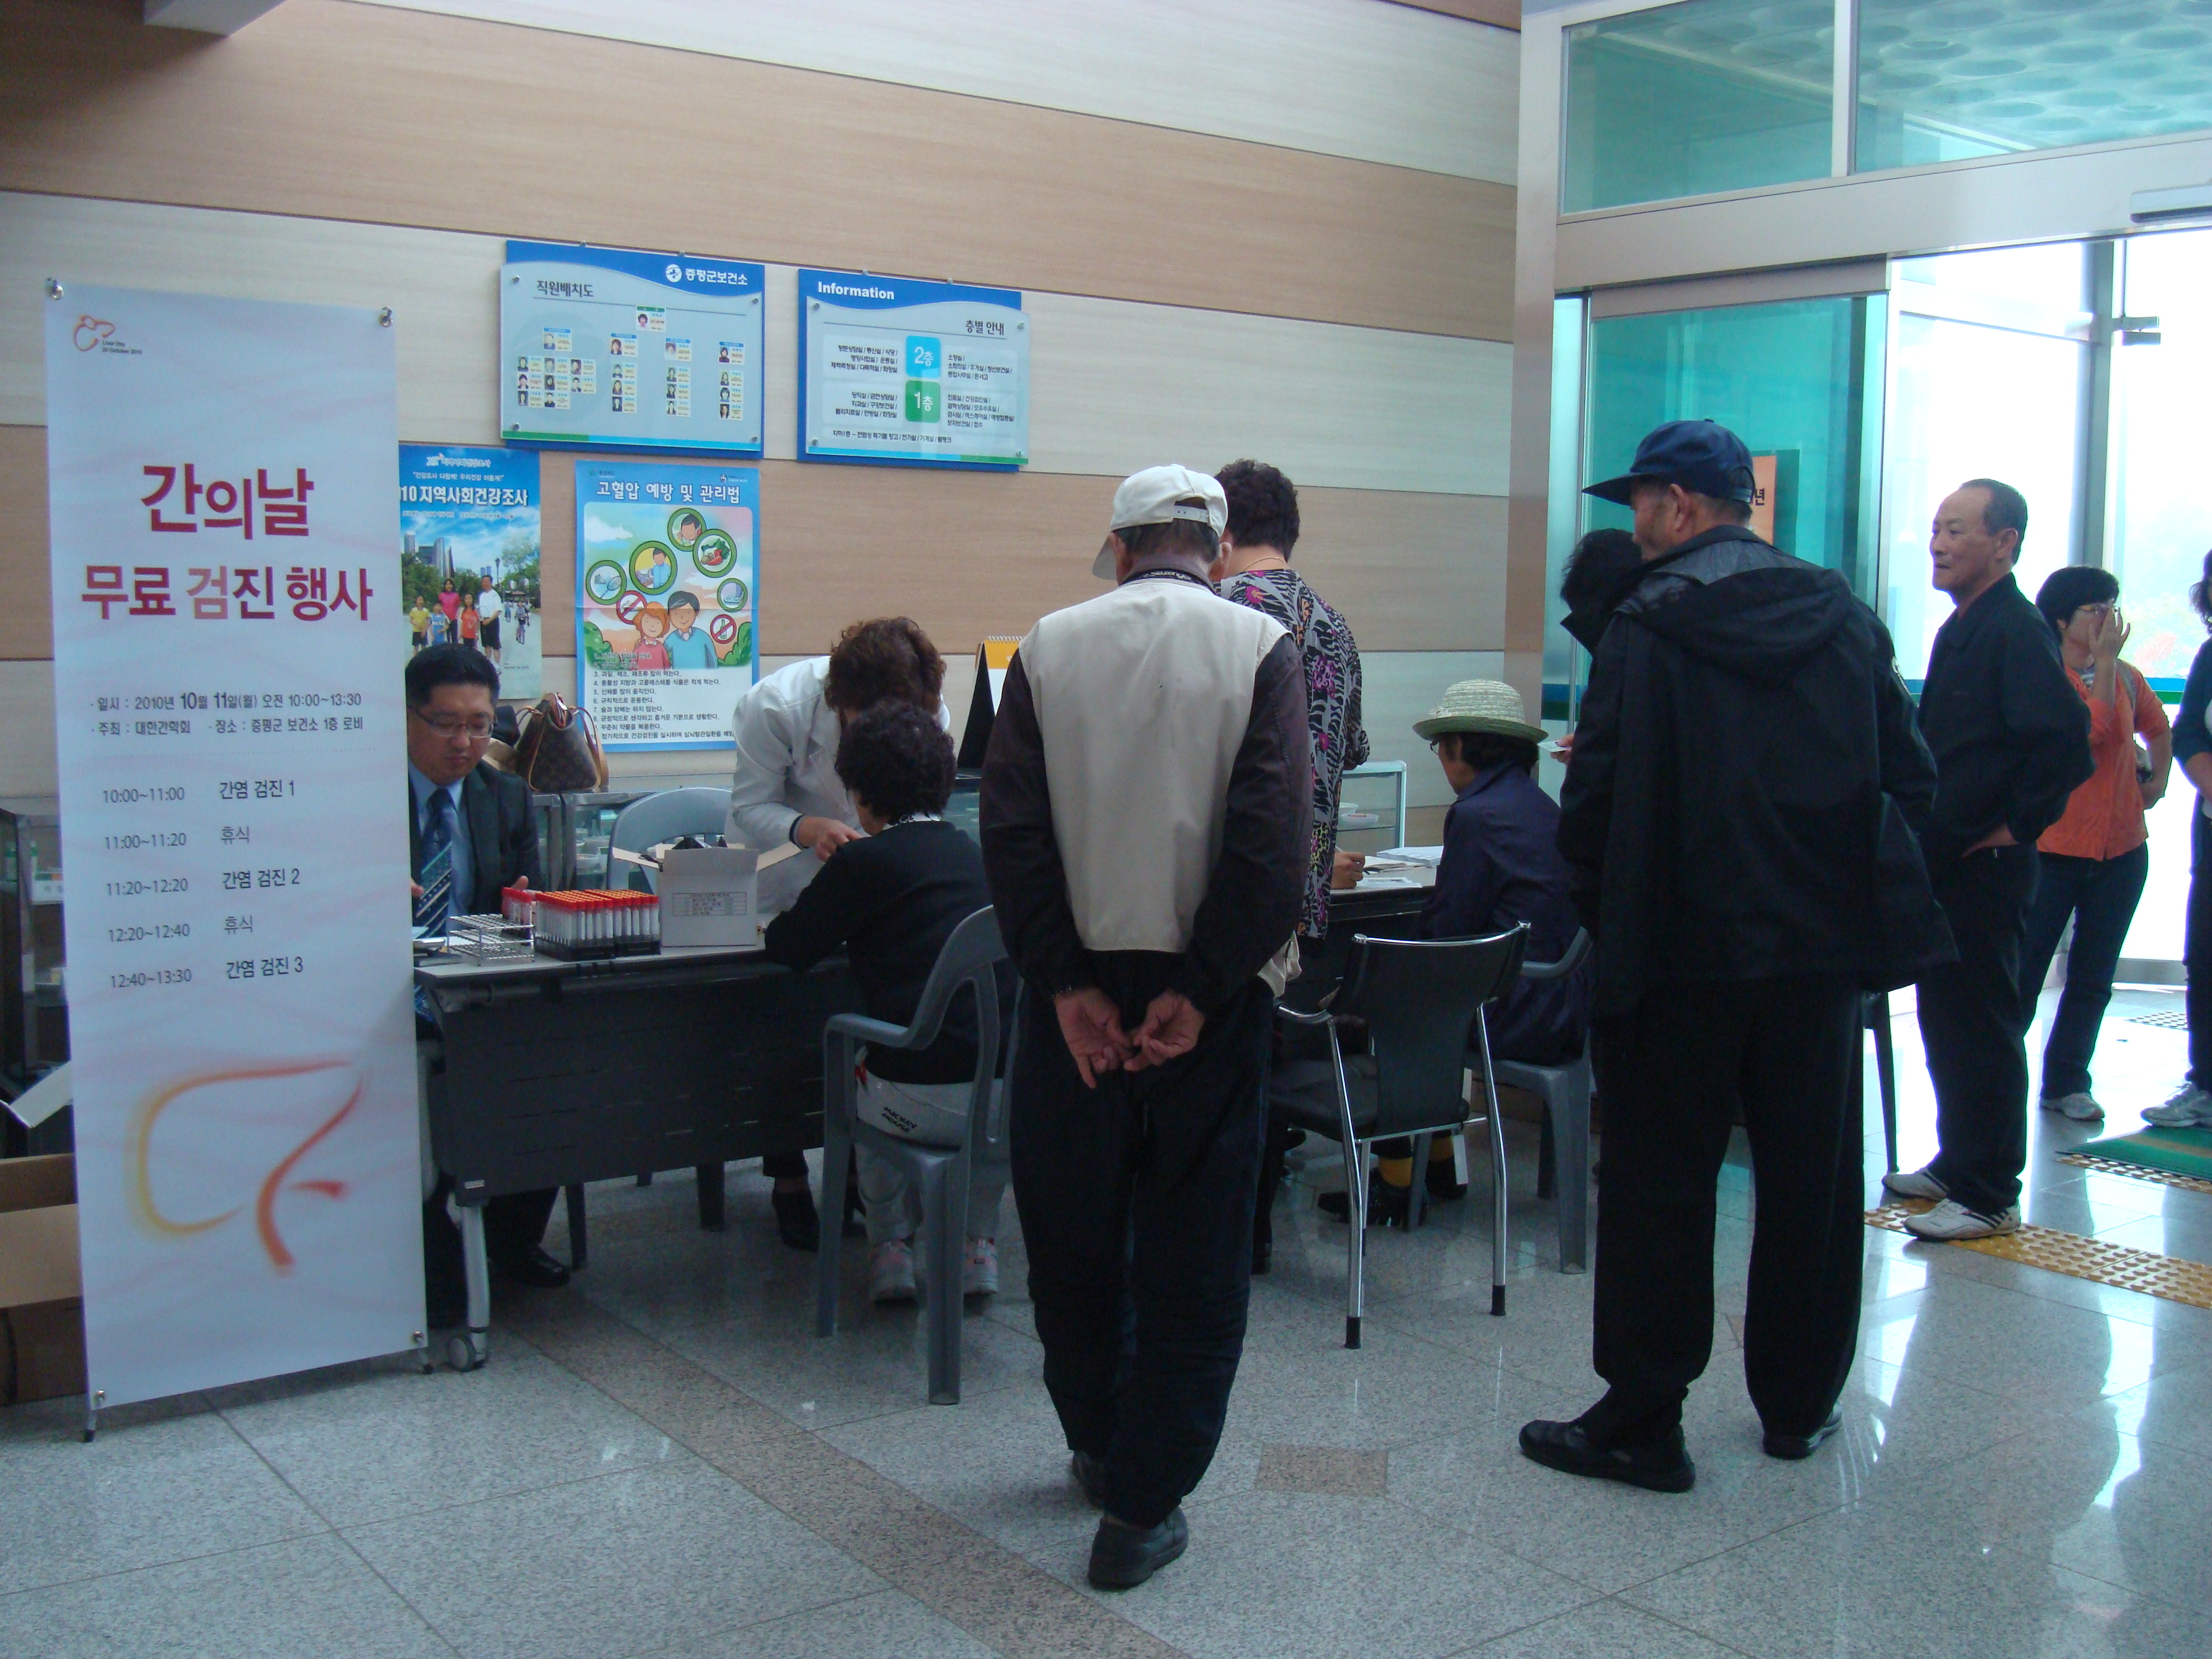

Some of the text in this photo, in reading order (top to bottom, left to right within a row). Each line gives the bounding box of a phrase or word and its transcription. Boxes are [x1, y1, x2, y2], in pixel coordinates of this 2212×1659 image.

[685, 268, 748, 286] 증평군보건소
[536, 280, 594, 298] 직원배치도
[817, 281, 895, 301] Information
[965, 320, 1005, 336] 층별 안내
[914, 346, 934, 367] 2층
[914, 392, 934, 412] 1층
[141, 463, 315, 540] 간의날
[400, 485, 528, 506] 10 지역사회건강조사
[597, 481, 740, 504] 고혈압 예방 및 관리법
[1750, 487, 1765, 507] 년
[81, 565, 374, 622] 무료 검진 행사
[97, 692, 362, 711] 일시 2010년 10월 11일(월) 오전 10:00~13:30
[98, 720, 191, 736] 주최 대한간학회
[215, 716, 363, 734] 장소 증평군 보건소 1층 로비
[102, 779, 295, 804] 10:00~11:00 간염 검진 1
[105, 826, 251, 850] 11:00~11:20 휴식
[107, 868, 300, 896] 11:20~12:20 간염 검진 2
[108, 915, 254, 942] 12:20~12:40 휴식
[111, 956, 304, 988] 12:40~13:30 간염 검진 3
